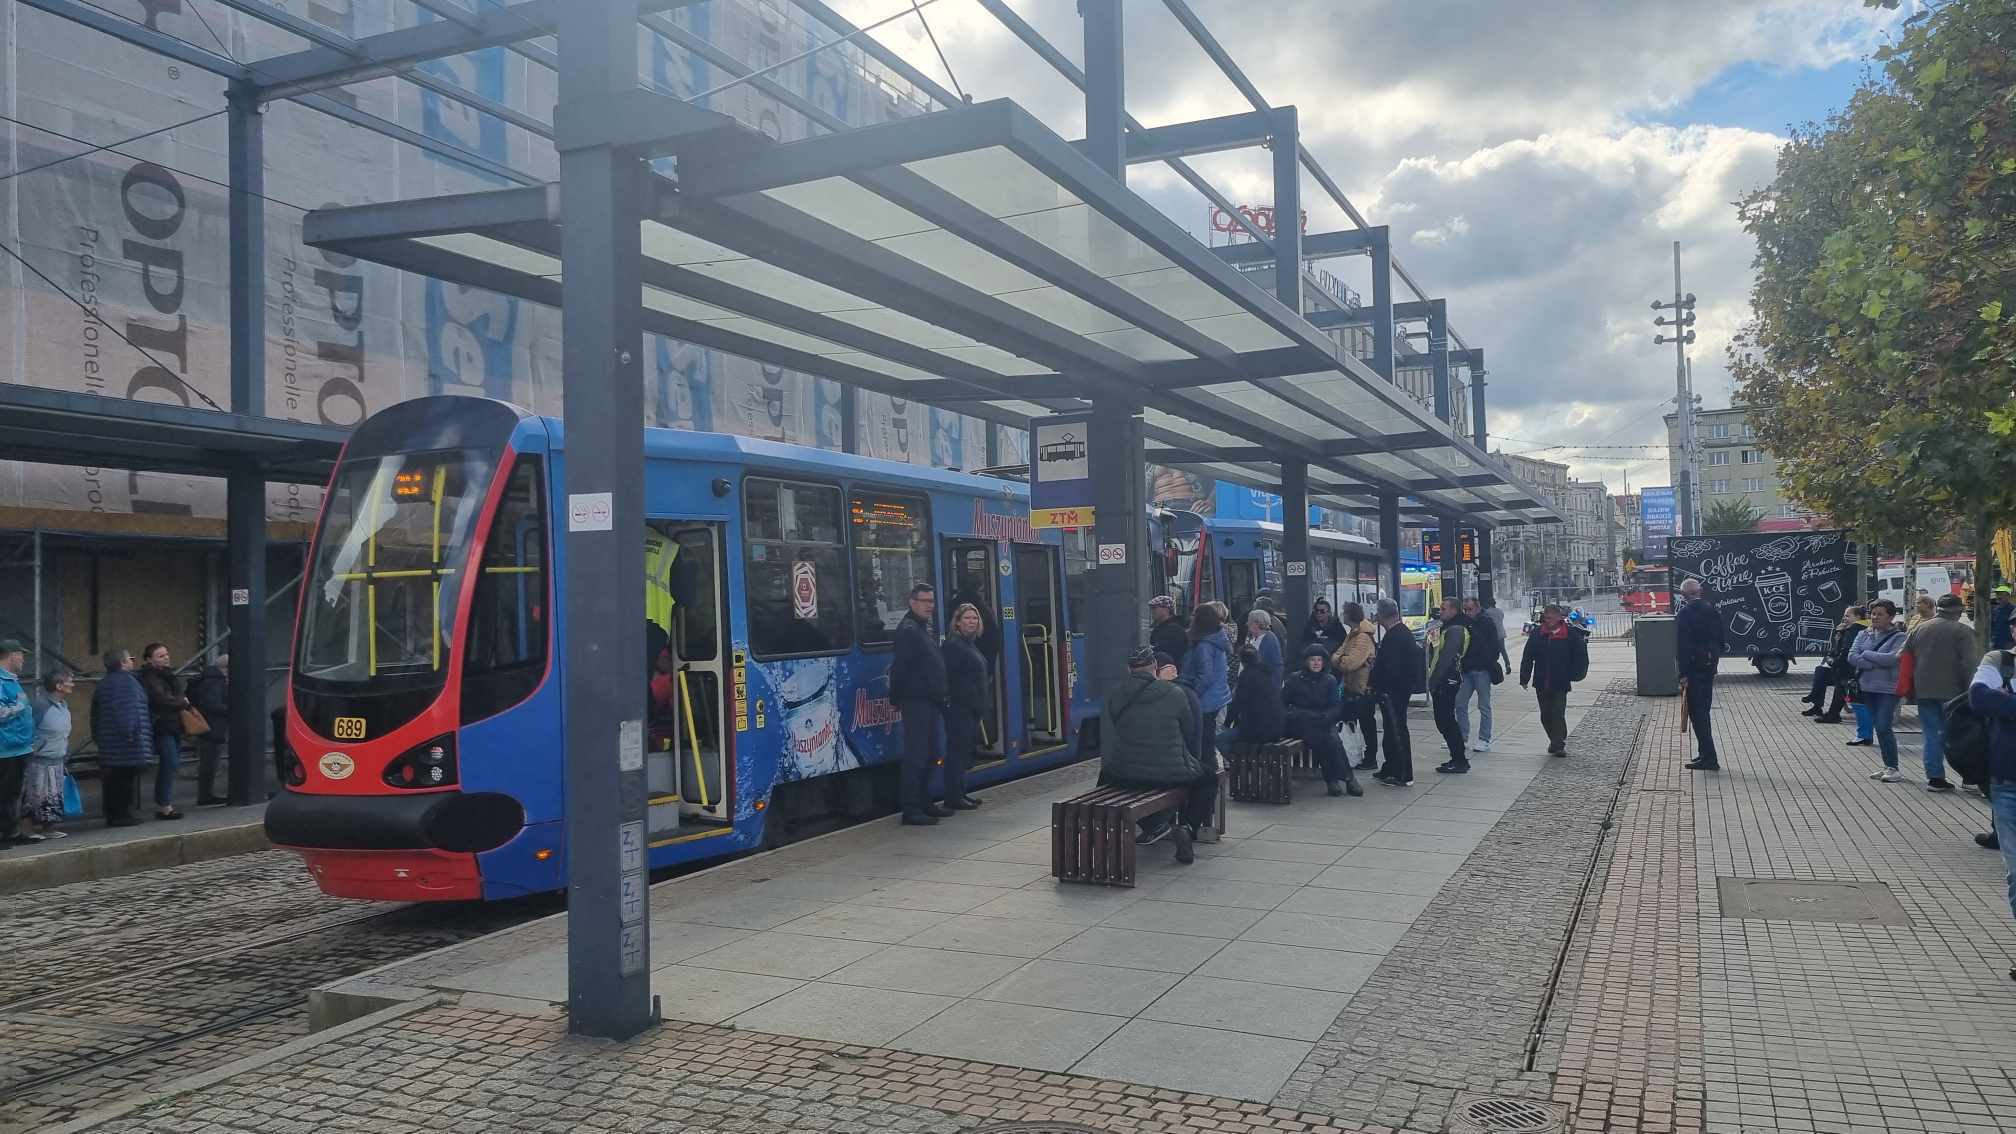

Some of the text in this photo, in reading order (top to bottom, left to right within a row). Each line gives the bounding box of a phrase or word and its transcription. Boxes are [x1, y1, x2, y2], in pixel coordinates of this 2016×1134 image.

[121, 162, 192, 512] OPTO
[1050, 511, 1078, 525] ZTM
[1700, 552, 1749, 577] Coffee
[1708, 570, 1753, 593] Time
[337, 719, 362, 737] 689
